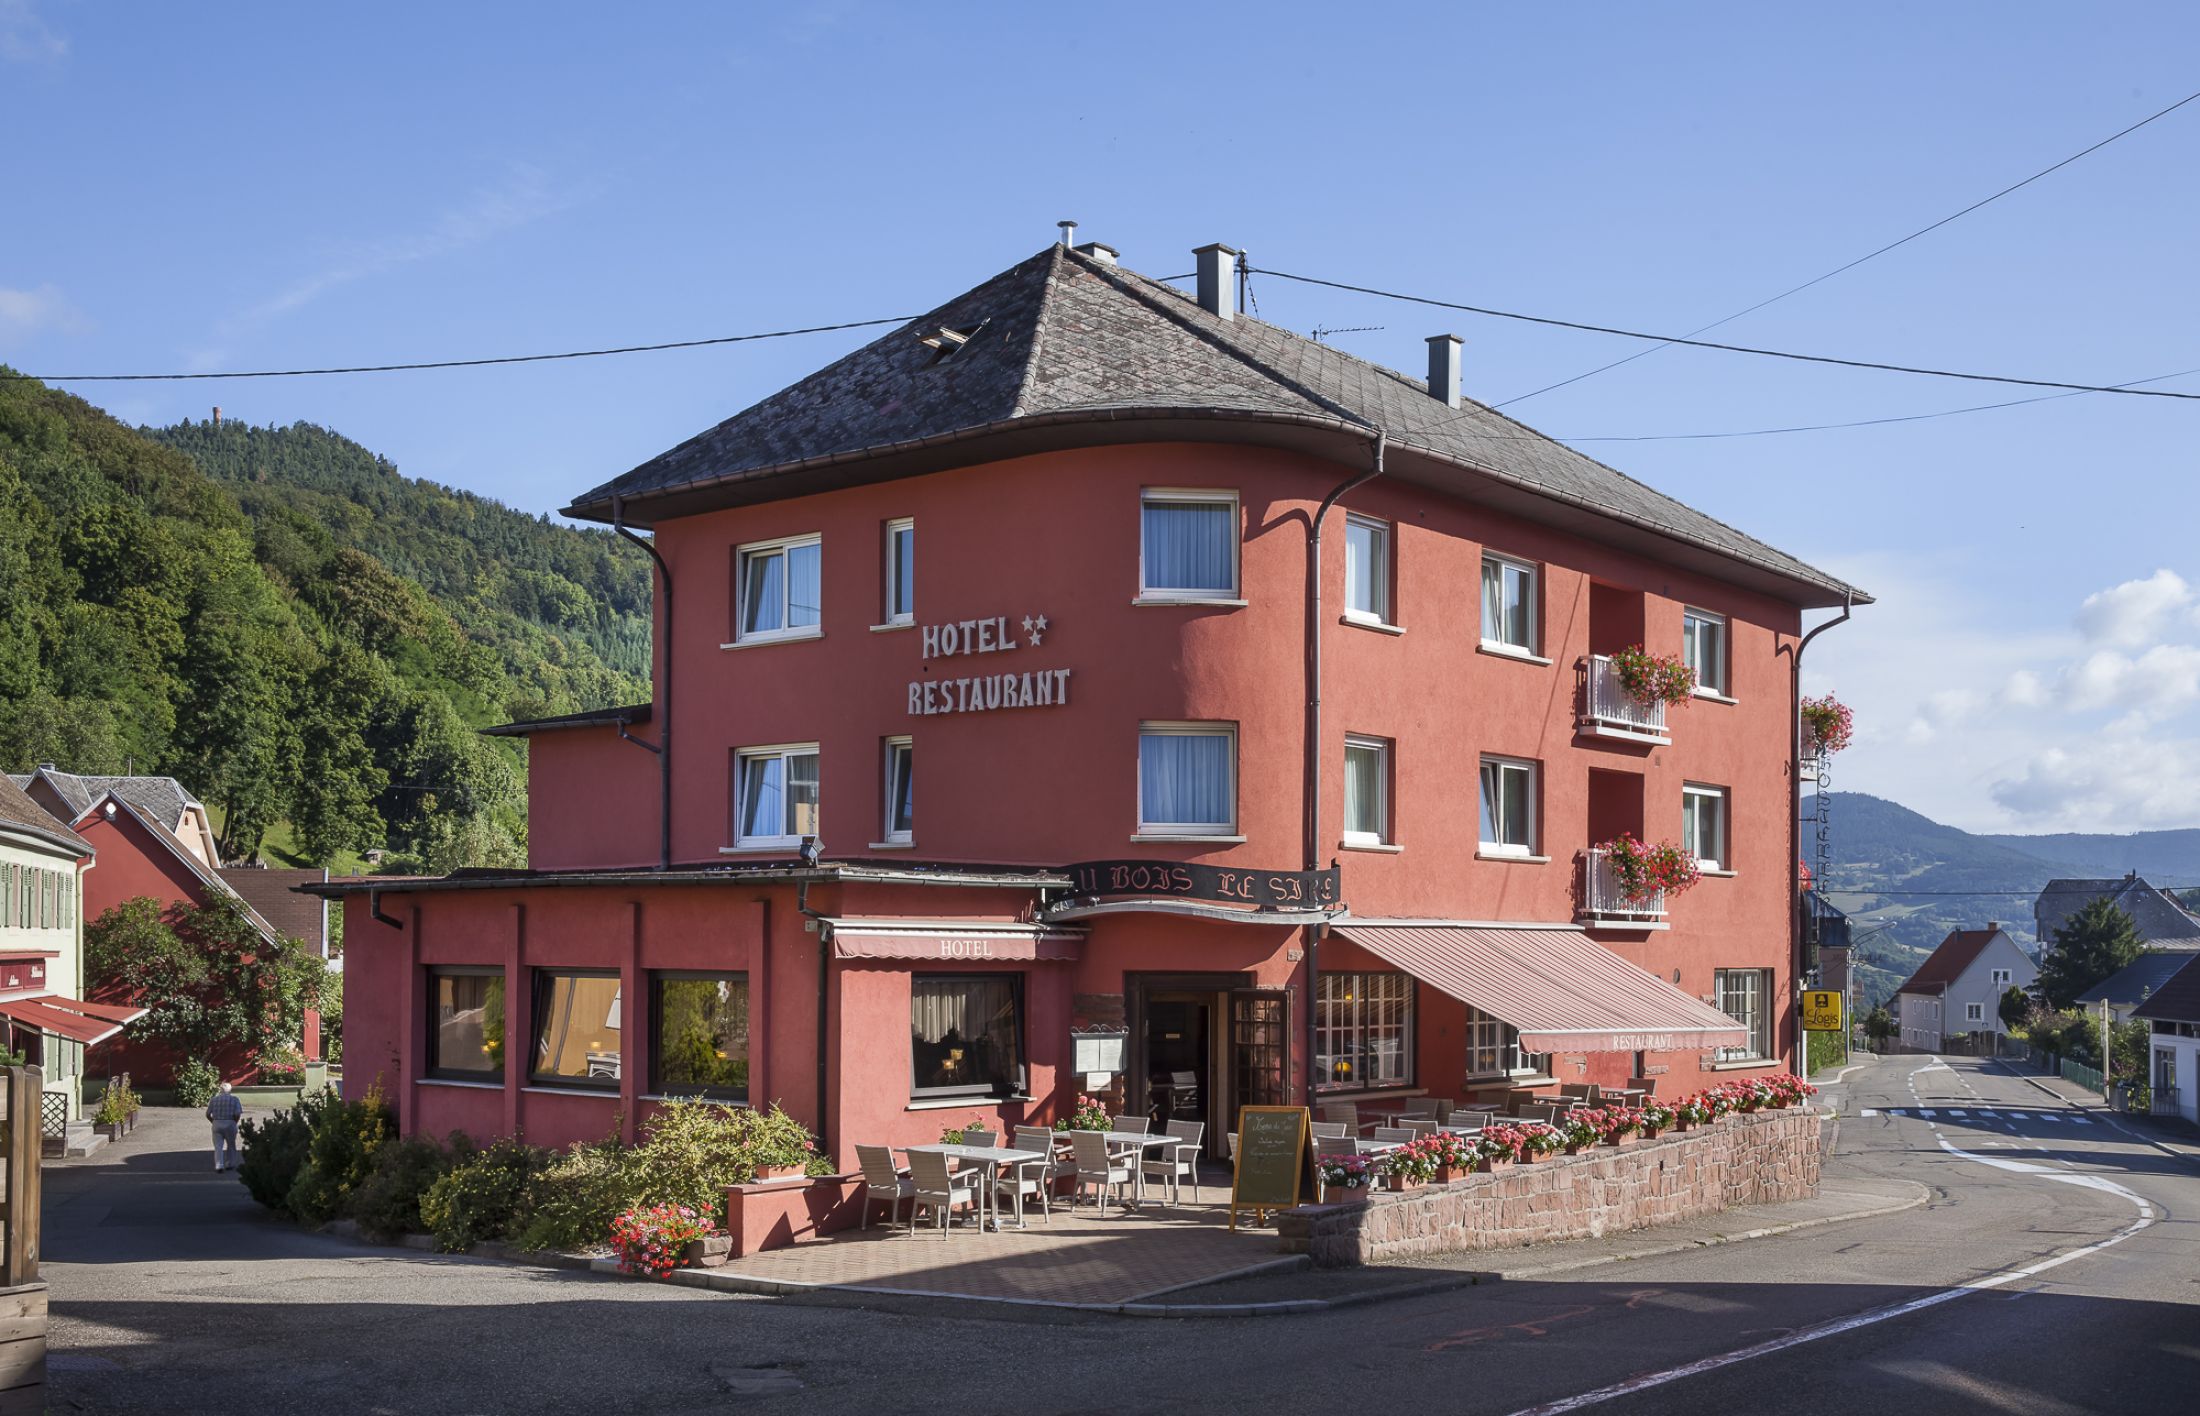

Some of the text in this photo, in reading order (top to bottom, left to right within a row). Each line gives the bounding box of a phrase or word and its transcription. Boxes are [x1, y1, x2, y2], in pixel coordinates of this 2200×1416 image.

[922, 616, 1016, 659] HOTEL
[908, 668, 1070, 714] RESTAURANT
[1080, 868, 1098, 891] U
[1109, 865, 1193, 891] BOIS
[1217, 873, 1255, 899] LE
[940, 940, 992, 956] HOTEL
[1805, 1008, 1839, 1028] Logis
[1613, 1033, 1673, 1049] RESTAURANT
